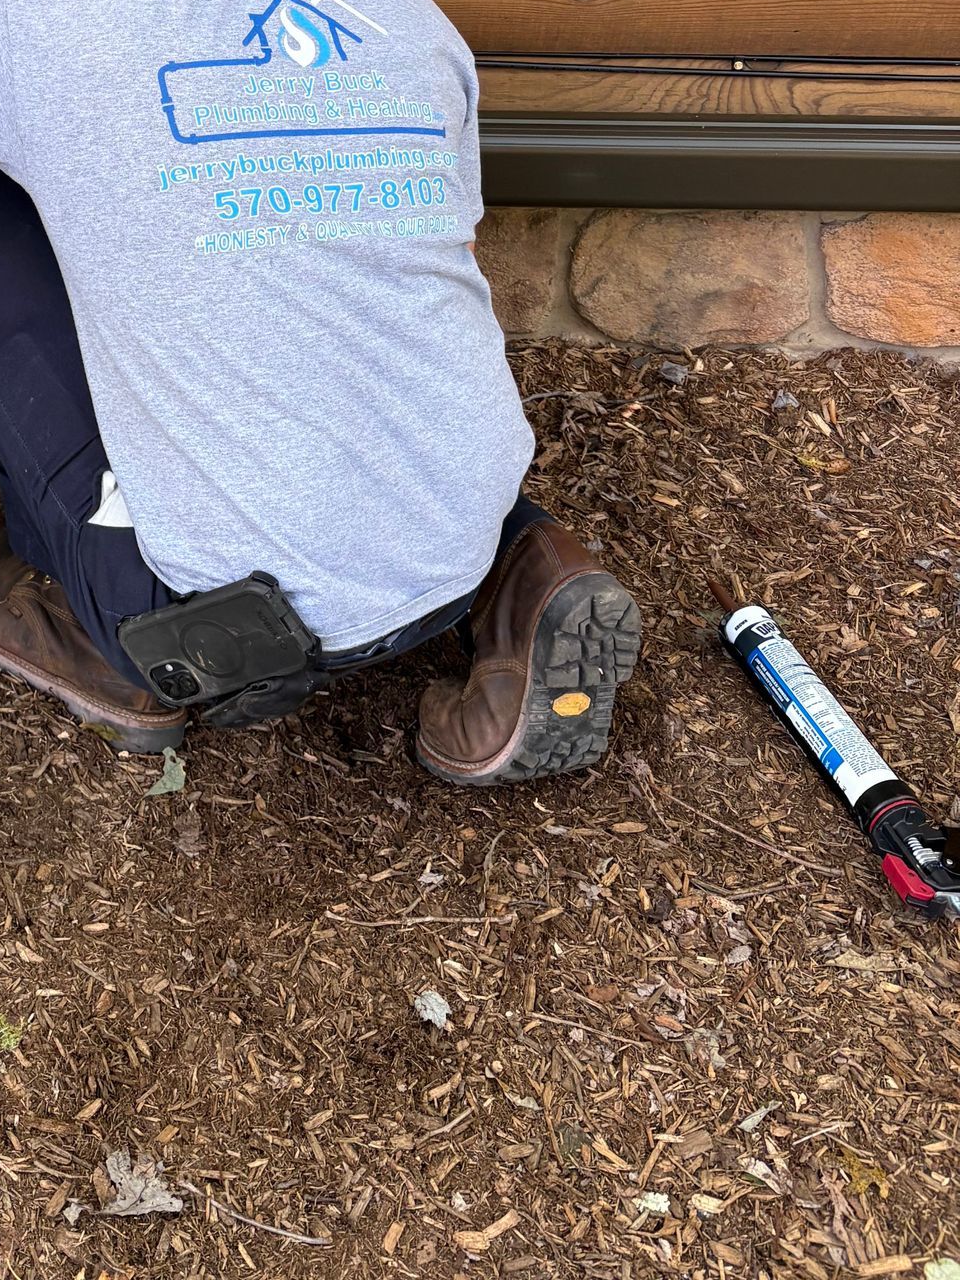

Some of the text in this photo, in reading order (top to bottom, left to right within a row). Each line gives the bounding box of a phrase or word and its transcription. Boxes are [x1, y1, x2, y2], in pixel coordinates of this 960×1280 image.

[244, 71, 388, 97] Jerry Buck
[193, 96, 432, 126] Plumbing & Heating
[213, 177, 446, 221] 570-977-8103
[296, 224, 309, 242] &
[316, 220, 373, 240] QUALITY
[376, 220, 392, 237] IS
[397, 217, 425, 237] OUR
